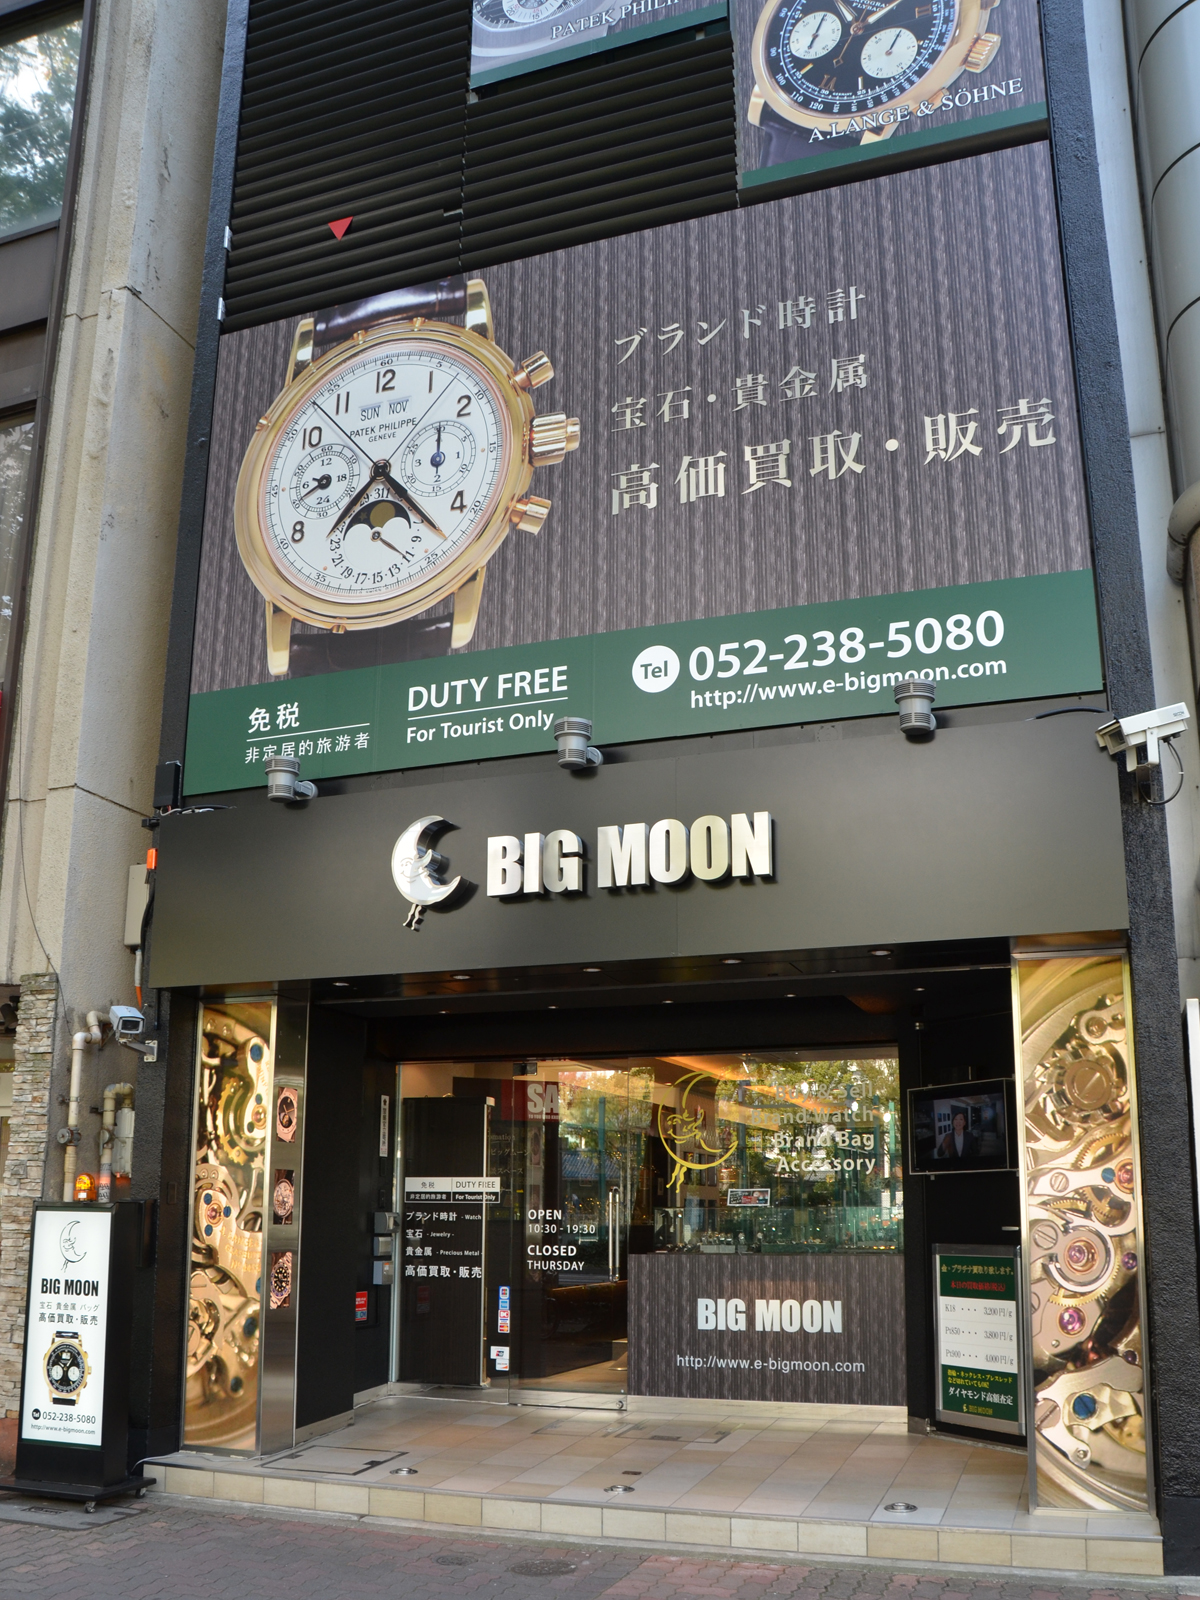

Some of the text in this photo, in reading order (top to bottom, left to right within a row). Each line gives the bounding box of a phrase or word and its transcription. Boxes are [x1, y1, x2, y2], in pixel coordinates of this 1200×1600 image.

[550, 11, 615, 41] PATEK
[775, 73, 786, 86] 100
[790, 91, 804, 103] 110
[916, 99, 936, 118] &
[941, 77, 1024, 112] SÖHNE
[809, 101, 824, 111] 120
[614, 286, 866, 365] ブランド時計
[380, 358, 393, 366] 60
[376, 368, 396, 394] 12
[428, 370, 434, 394] 1
[474, 389, 485, 400] 10
[611, 354, 868, 432] 宝石・貴金属
[335, 391, 350, 416] 11
[360, 400, 408, 421] SUN NOV
[456, 394, 472, 418] 2
[350, 417, 417, 438] PATEK PHILIPPE
[302, 426, 323, 451] 10
[456, 451, 460, 459] 1
[611, 397, 1056, 515] 高価買取・販売
[320, 458, 332, 467] 12
[414, 459, 422, 467] 3
[302, 481, 310, 489] 6
[336, 474, 347, 482] 18
[434, 474, 442, 483] 2
[316, 495, 330, 505] 24
[451, 490, 467, 514] 4
[291, 520, 305, 544] 8
[329, 538, 341, 551] 23
[331, 554, 345, 568] 21
[340, 566, 354, 579] 19
[388, 563, 401, 577] 13
[354, 572, 368, 585] 17
[372, 571, 383, 584] 15
[640, 610, 1005, 681] Tel 052-238-5080
[408, 665, 568, 712] DUTY FREE
[690, 658, 1007, 709] http://www.e-bigmoon.com
[248, 702, 300, 733] 免税
[407, 709, 554, 744] For Tourist Only
[245, 732, 370, 764] 非定居的旅游者
[487, 811, 774, 898] BIG MOON
[776, 1081, 873, 1103] Buy & Sell
[751, 1105, 874, 1125] Brand Watch
[774, 1131, 875, 1150] Brand Bag
[777, 1156, 876, 1175] Accessory
[455, 1181, 476, 1189] DUTY
[406, 1211, 458, 1221] ブランド時計
[528, 1209, 562, 1220] OPEN
[406, 1229, 423, 1238] 宝石
[529, 1224, 595, 1234] 10:30 19:30
[405, 1247, 433, 1256] 貴金属
[527, 1245, 577, 1256] CLOSED
[405, 1265, 482, 1278] 高価買取・販売
[527, 1260, 584, 1271] THURSDAY
[41, 1278, 99, 1297] BIG MOON
[39, 1301, 100, 1312] 宝石 貴金属 バッグ
[945, 1304, 956, 1312] K18
[39, 1312, 98, 1325] 高価買取・販売
[697, 1298, 842, 1333] BIG MOON
[676, 1354, 865, 1373] http://www.e-bigmoon.com
[949, 1386, 1014, 1405] ダイヤモンド高額査定
[42, 1411, 96, 1425] 052-238-5080
[31, 1423, 96, 1435] http://www.e-bigmoon.com
